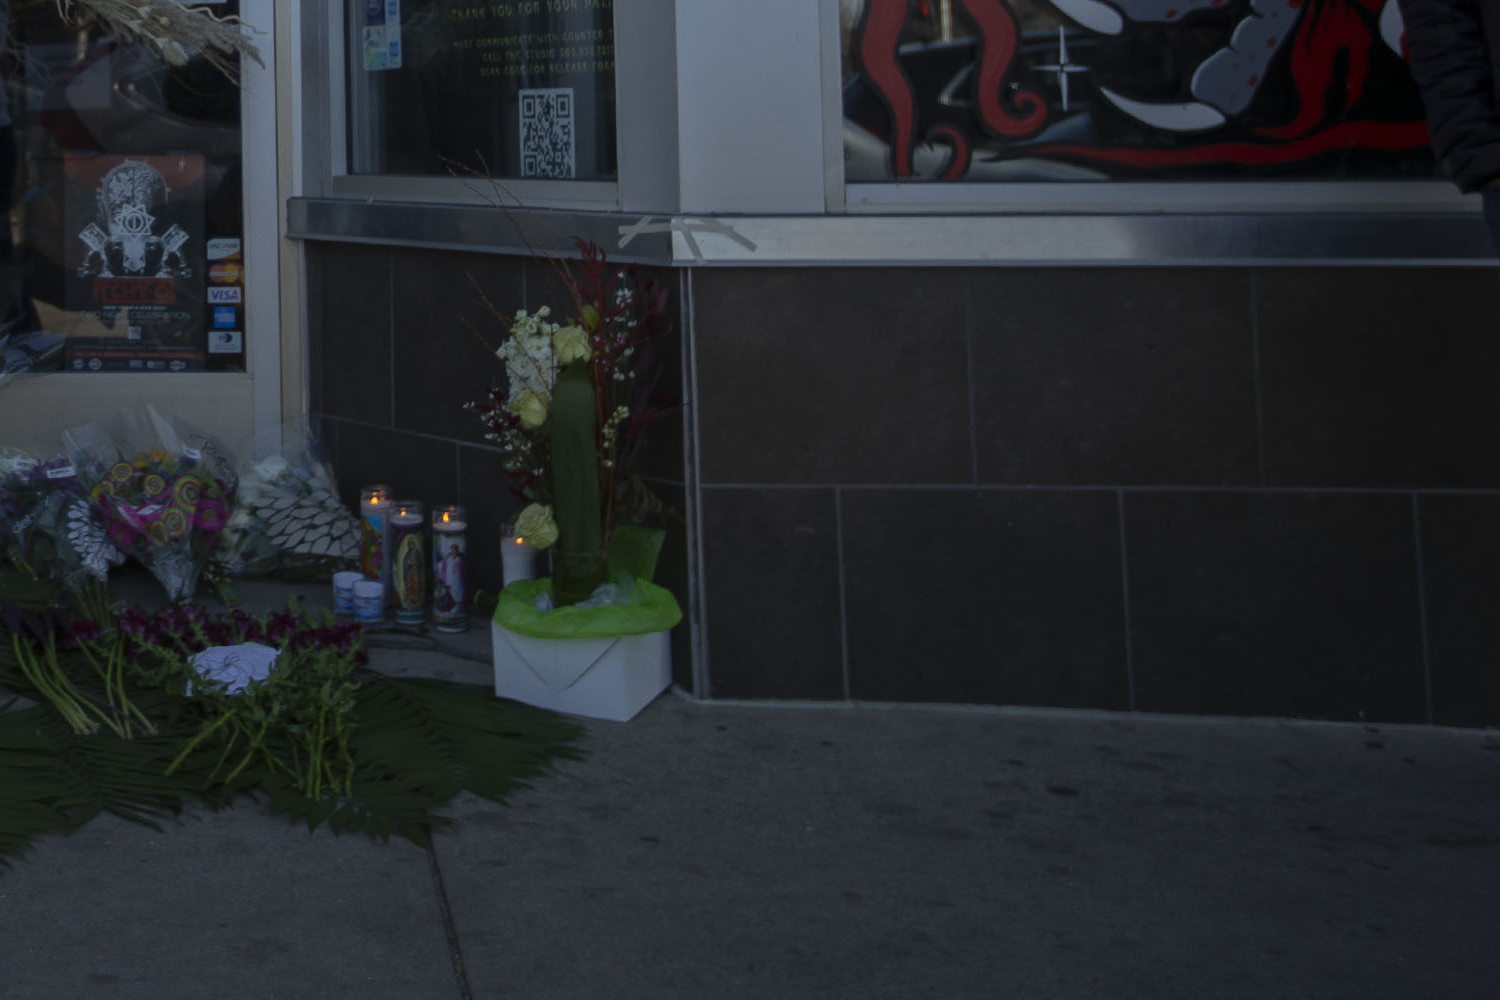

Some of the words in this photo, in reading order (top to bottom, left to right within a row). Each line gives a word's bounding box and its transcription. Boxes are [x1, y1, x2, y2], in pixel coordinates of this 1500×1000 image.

[452, 7, 485, 21] THANK
[491, 3, 513, 17] YOU
[517, 0, 541, 16] FOR
[562, 28, 604, 42] COUNTER
[212, 290, 239, 300] VISA
